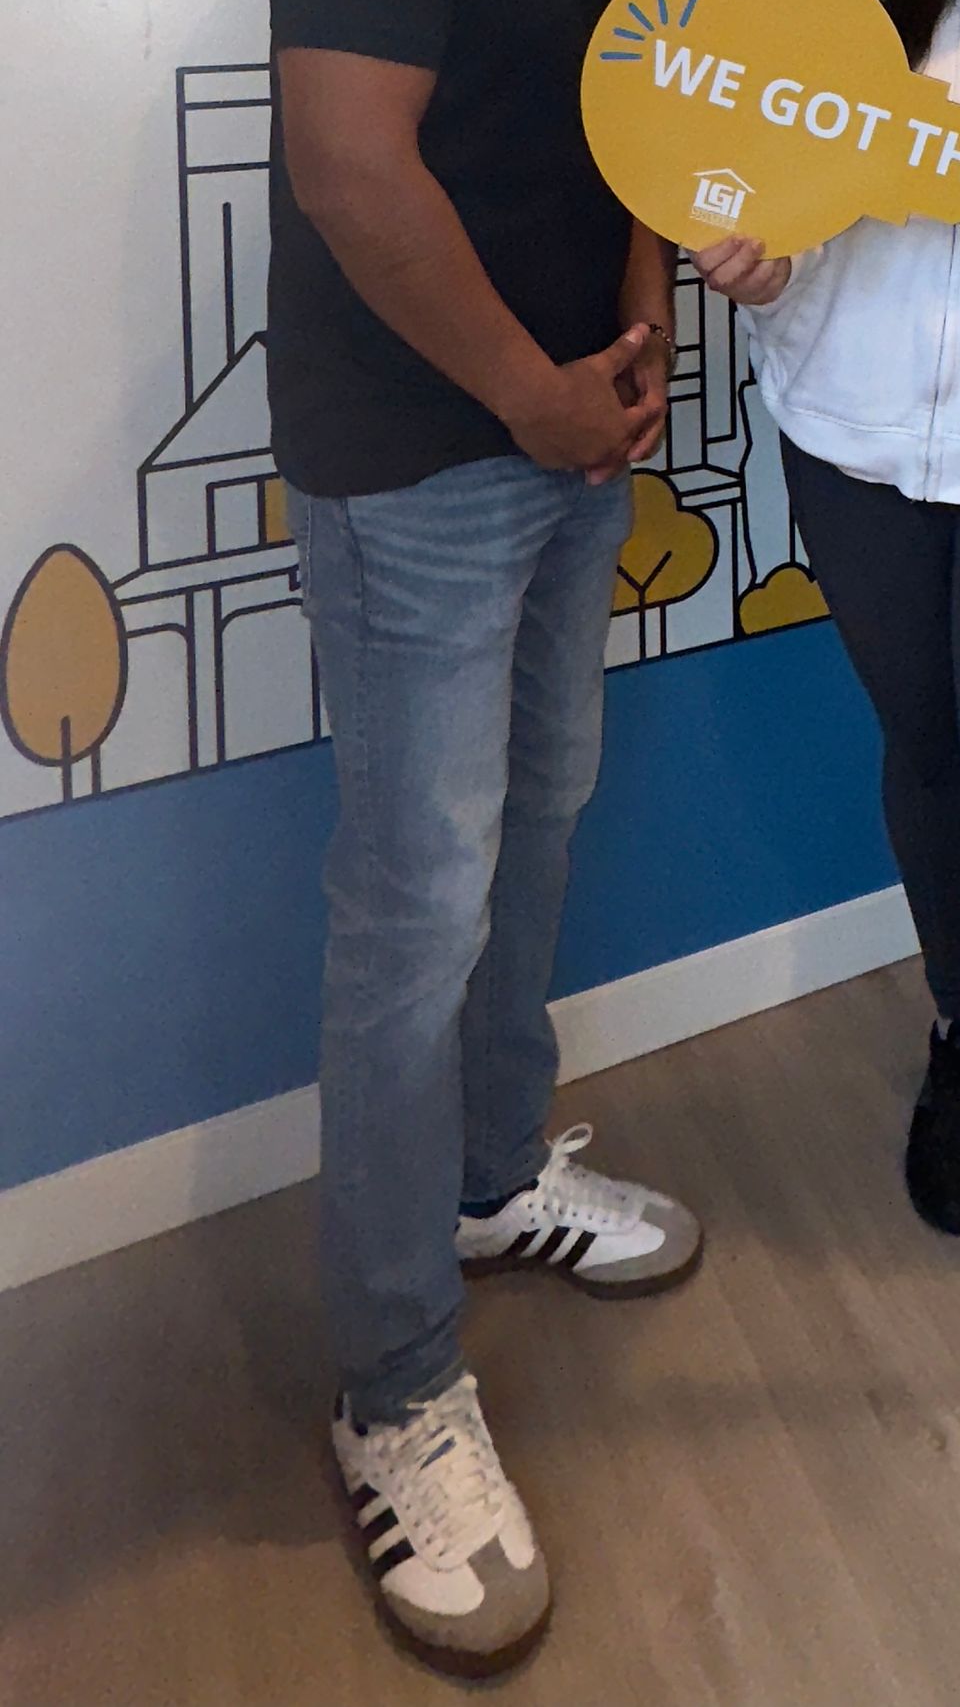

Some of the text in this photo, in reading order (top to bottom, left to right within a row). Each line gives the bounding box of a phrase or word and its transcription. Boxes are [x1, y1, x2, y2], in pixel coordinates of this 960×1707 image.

[652, 38, 747, 109] WE
[760, 79, 892, 151] GOT
[694, 178, 746, 219] LGI
